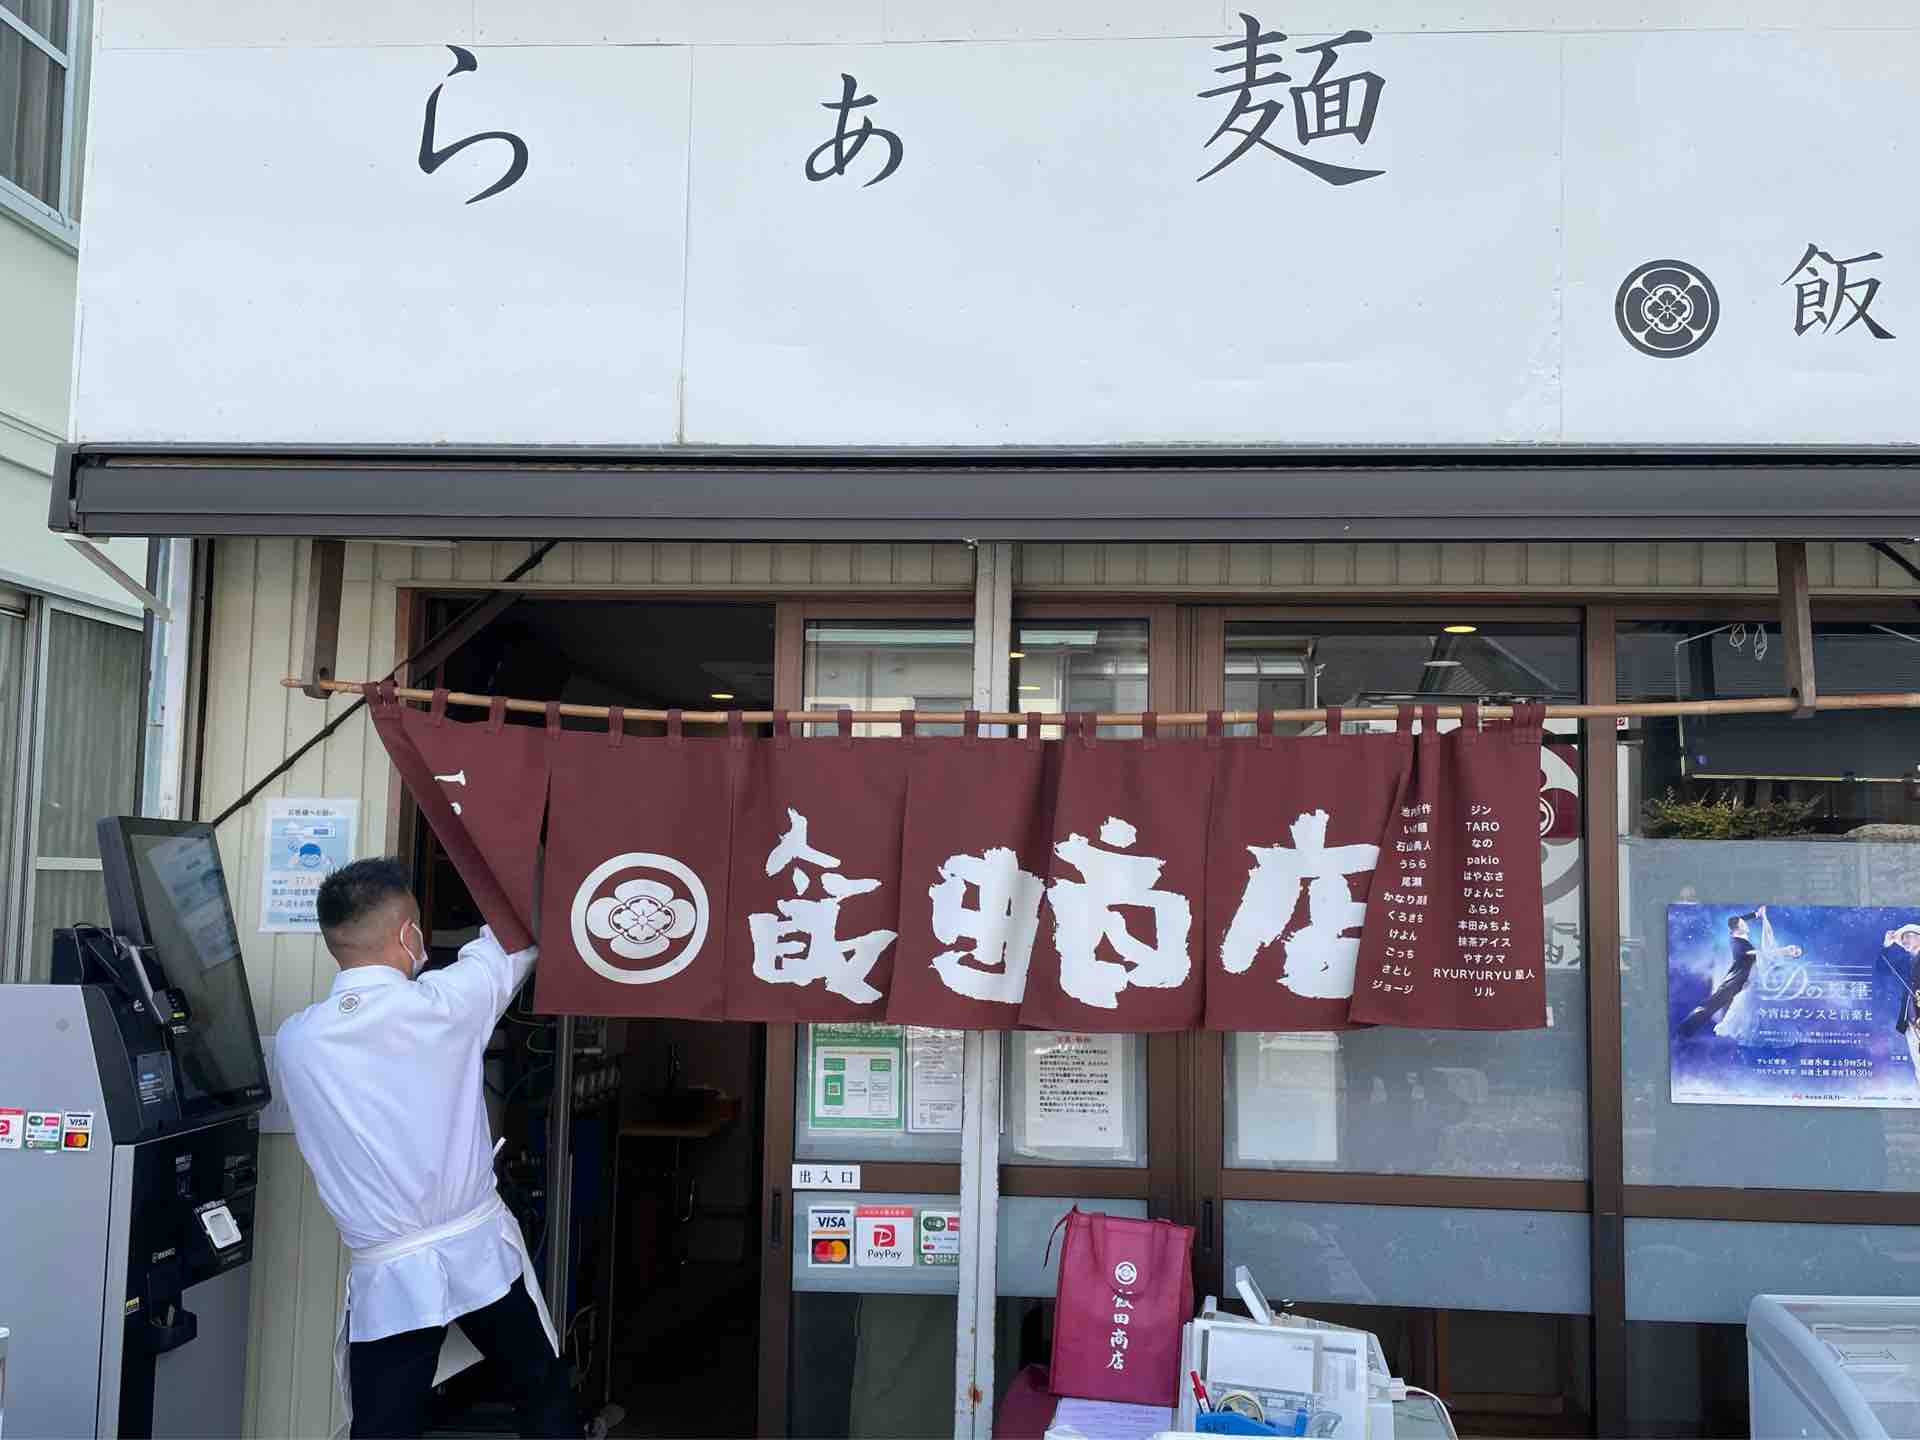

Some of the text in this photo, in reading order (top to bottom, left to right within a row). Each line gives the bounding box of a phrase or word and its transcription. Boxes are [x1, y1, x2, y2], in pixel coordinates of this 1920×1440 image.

[1780, 243, 1897, 340] 飯
[1465, 821, 1500, 833] TARO
[1471, 838, 1493, 849] なの
[1466, 855, 1500, 867] pakio
[1371, 979, 1414, 994] ジョージ
[1474, 986, 1496, 997] リル
[69, 1118, 88, 1127] VISA
[800, 1170, 853, 1184] 出入口
[817, 1217, 847, 1228] VISA
[867, 1248, 903, 1259] PayPay
